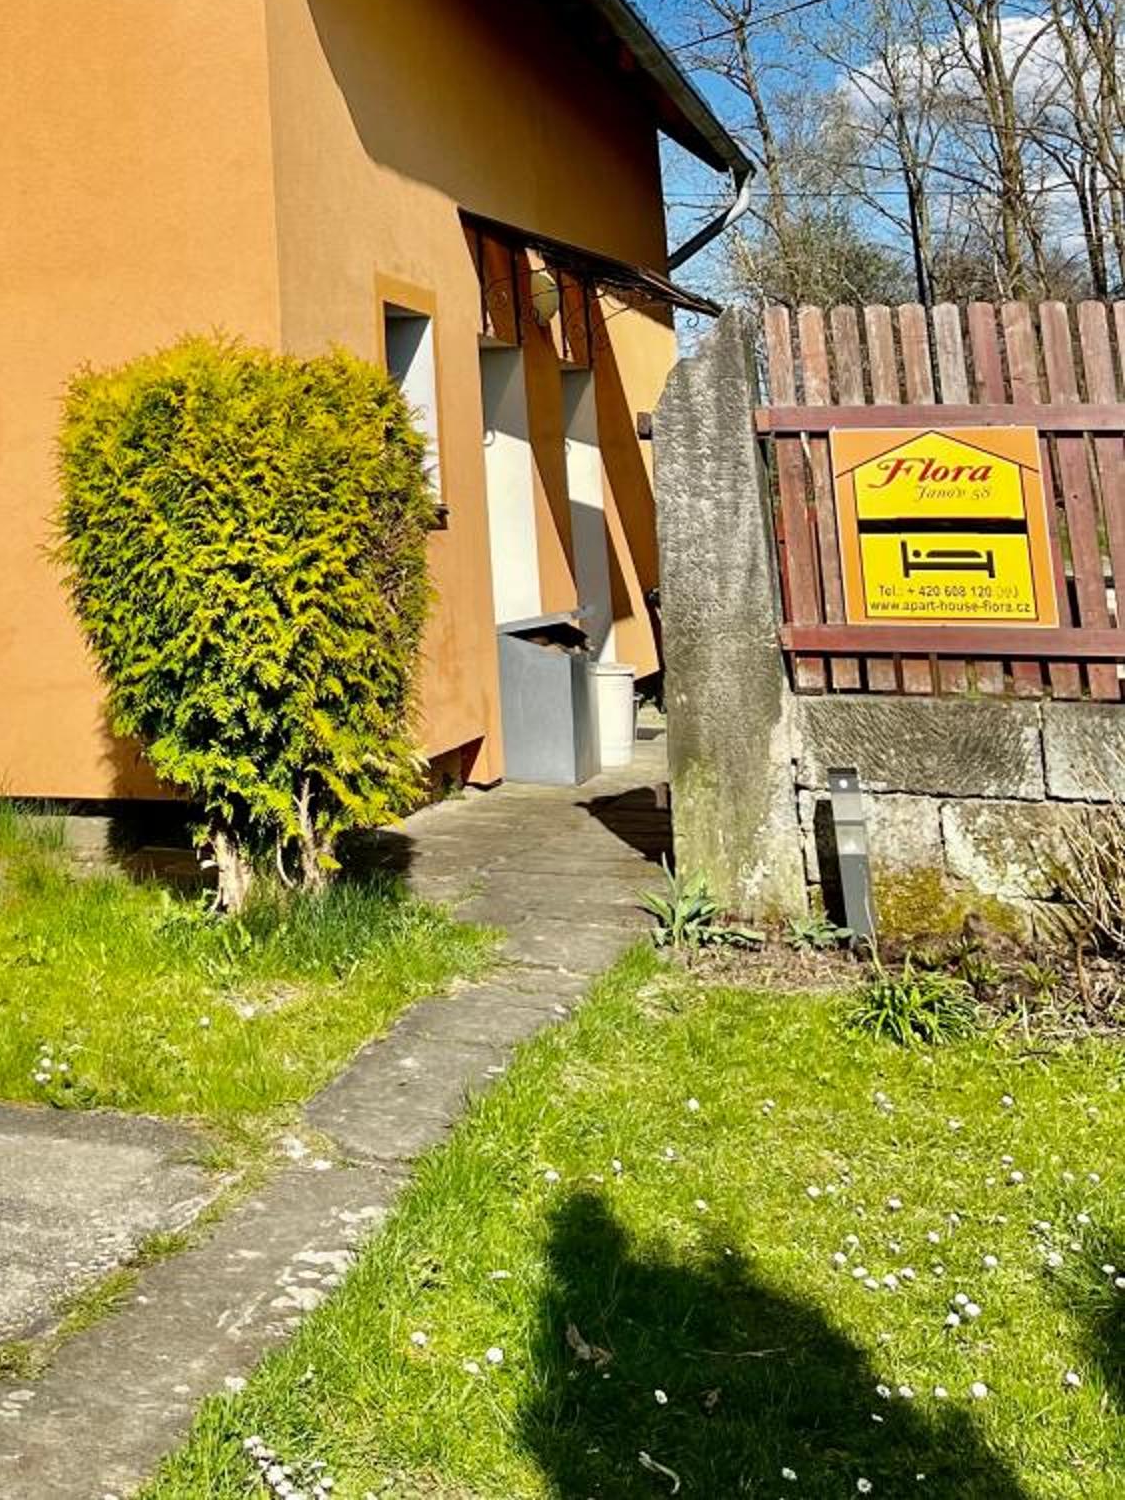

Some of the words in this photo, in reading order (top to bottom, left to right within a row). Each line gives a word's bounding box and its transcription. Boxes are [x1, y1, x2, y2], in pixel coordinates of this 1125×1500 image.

[868, 457, 992, 489] Flora
[918, 585, 940, 598] 420
[971, 585, 992, 598] 120
